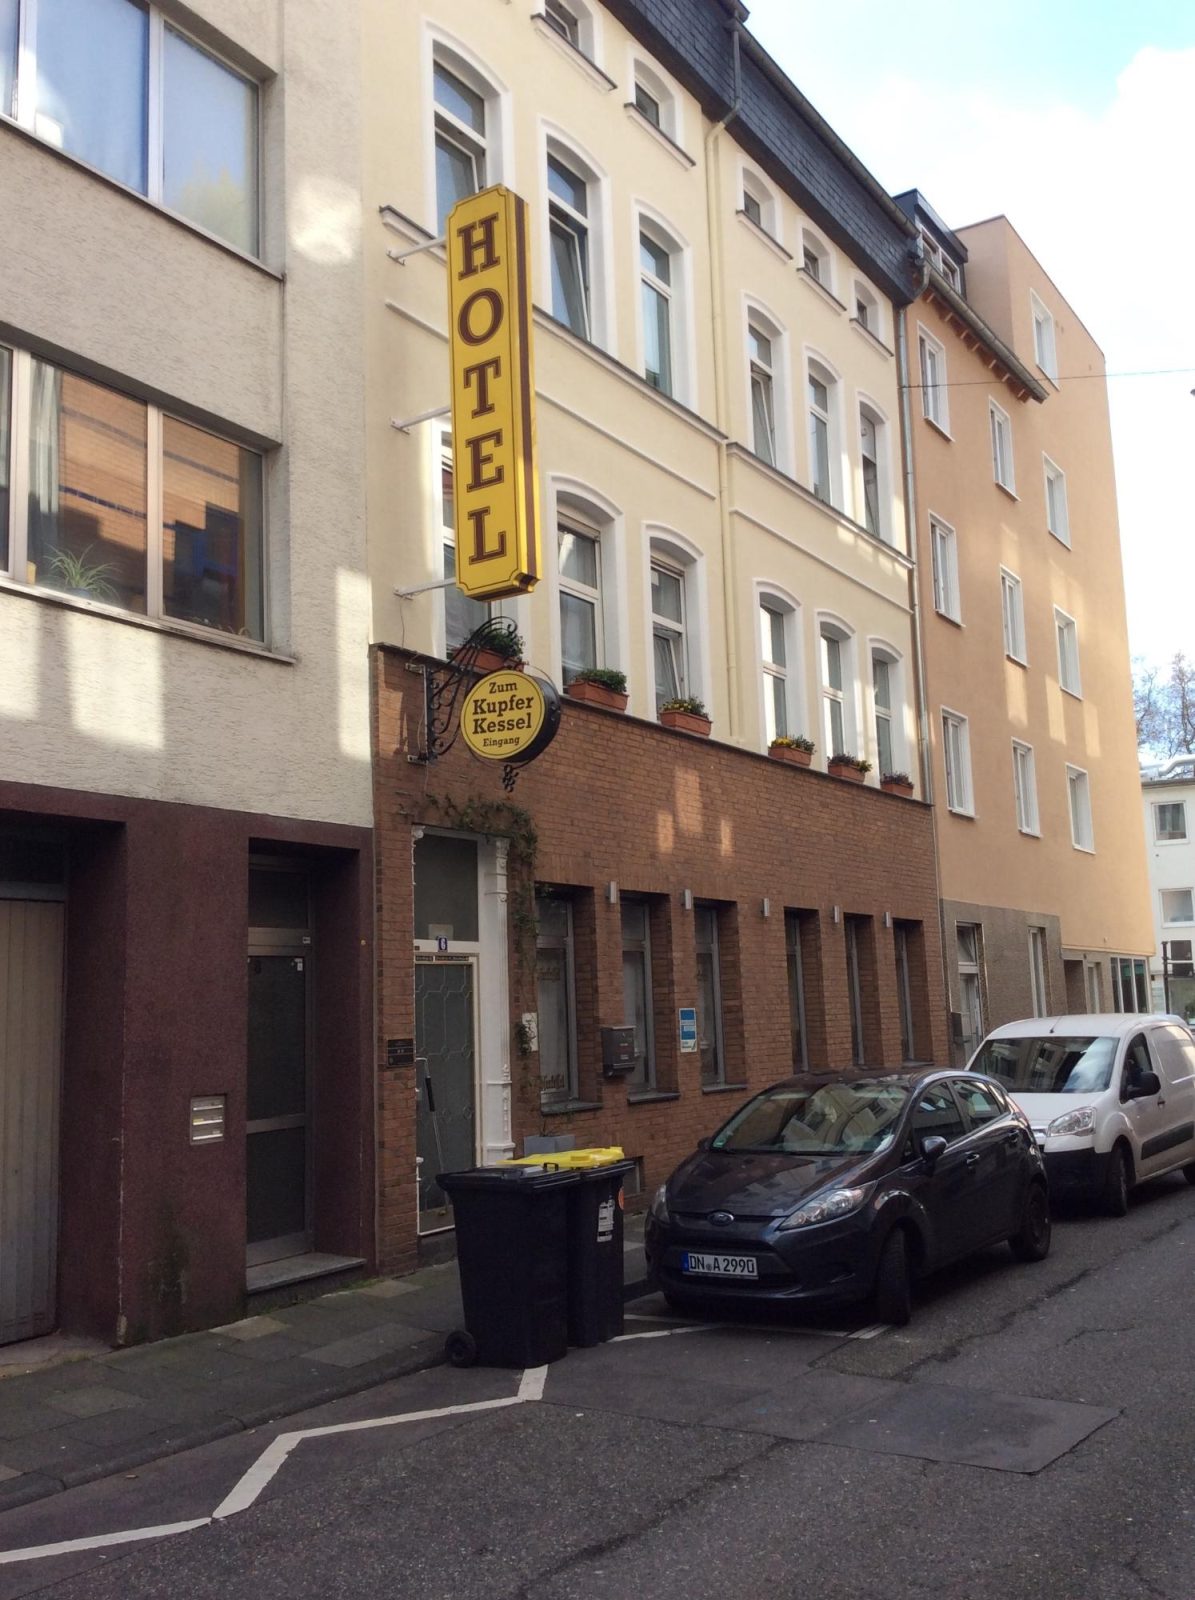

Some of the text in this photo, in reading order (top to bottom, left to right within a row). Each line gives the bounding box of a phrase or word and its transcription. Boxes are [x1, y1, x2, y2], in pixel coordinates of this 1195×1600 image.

[457, 212, 507, 565] HOTEL
[489, 682, 518, 694] Zum
[472, 695, 534, 717] Kupfer
[472, 713, 531, 734] Kessel
[483, 737, 520, 747] Eingang
[689, 1255, 705, 1270] DN
